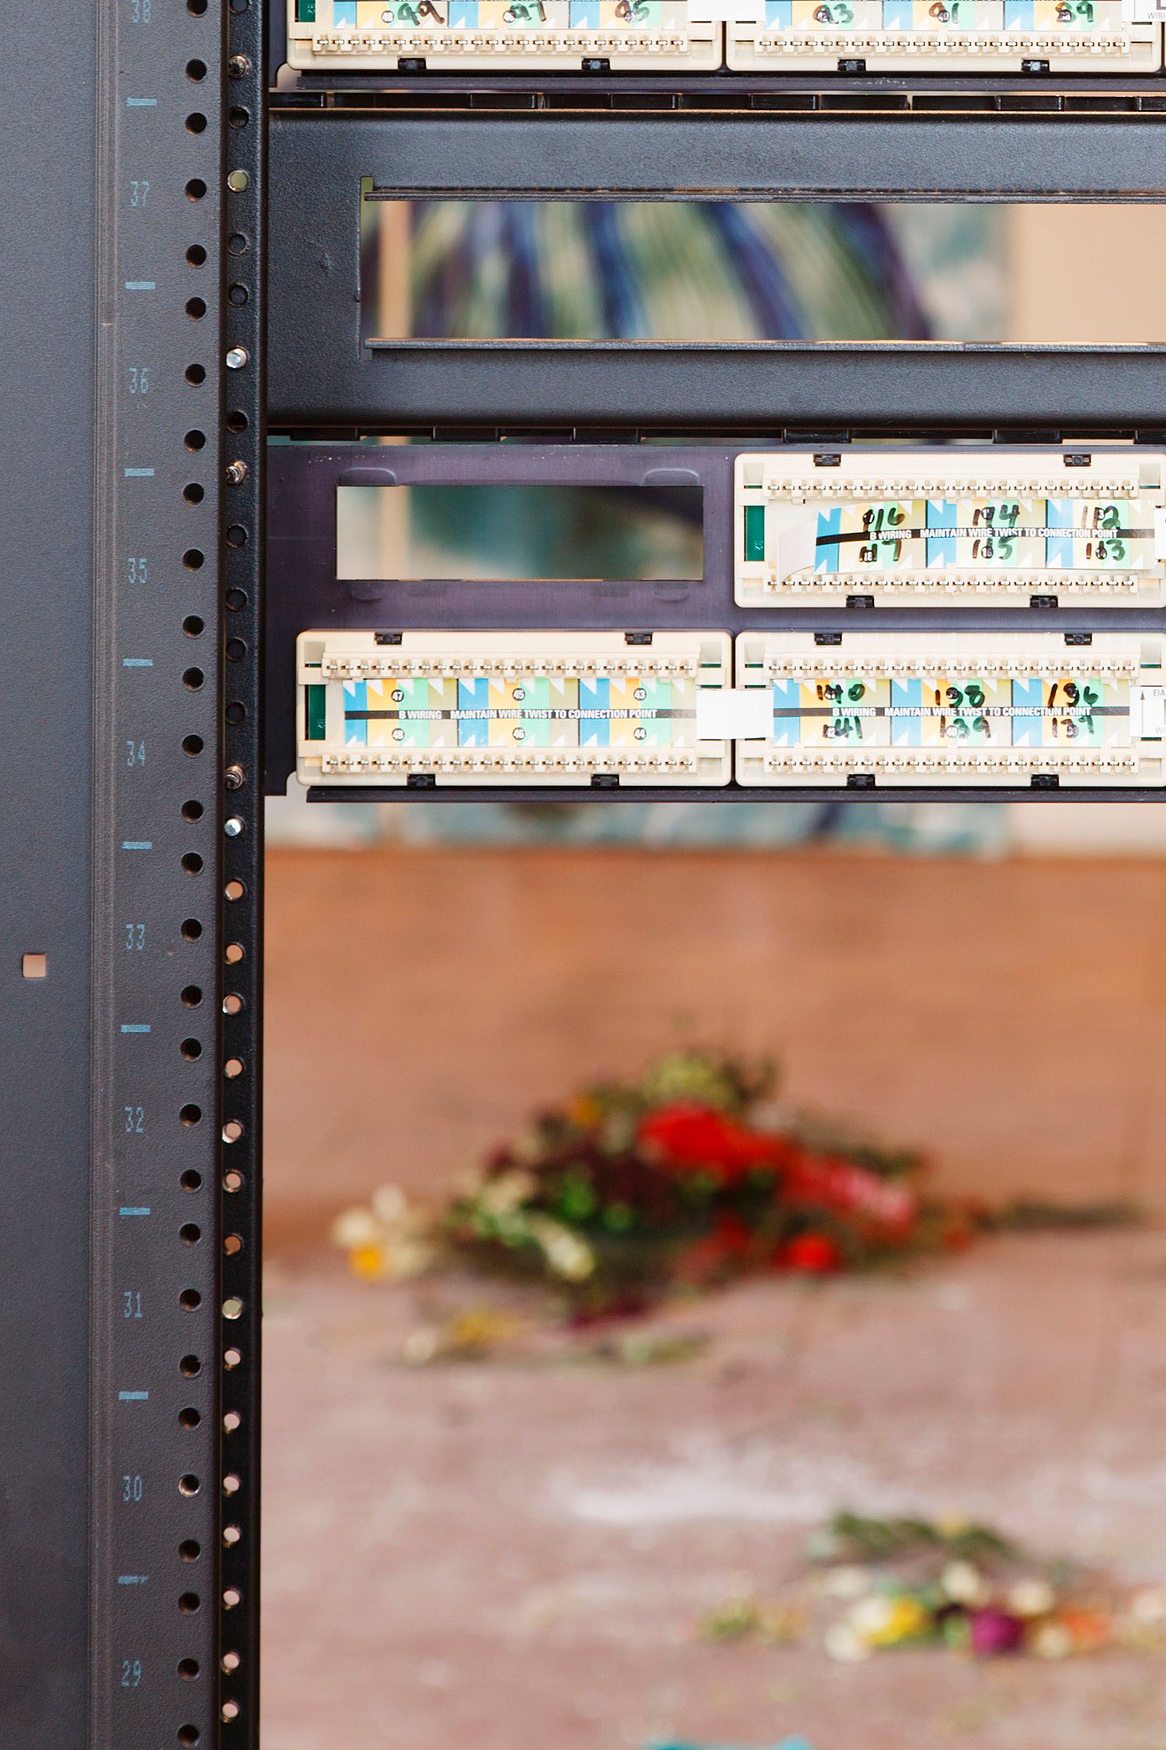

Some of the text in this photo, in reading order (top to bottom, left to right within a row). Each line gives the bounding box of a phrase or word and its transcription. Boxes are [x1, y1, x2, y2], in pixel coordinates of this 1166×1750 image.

[397, 1, 445, 27] 99
[130, 181, 150, 207] 37
[129, 367, 149, 394] 36
[129, 557, 148, 583] 35
[935, 685, 986, 709] 138
[1047, 682, 1098, 708] 136
[407, 710, 442, 719] WIRING
[450, 710, 497, 719] MAINTAIN
[498, 710, 523, 719] WIRE
[523, 710, 554, 719] TWIST
[555, 709, 567, 718] TO
[568, 709, 628, 718] CONNECTION
[629, 709, 657, 718] POINT
[127, 740, 146, 766] 34
[126, 924, 145, 951] 33
[124, 1107, 144, 1134] 32
[124, 1291, 143, 1319] 31
[123, 1475, 142, 1502] 30
[122, 1661, 142, 1688] 29
